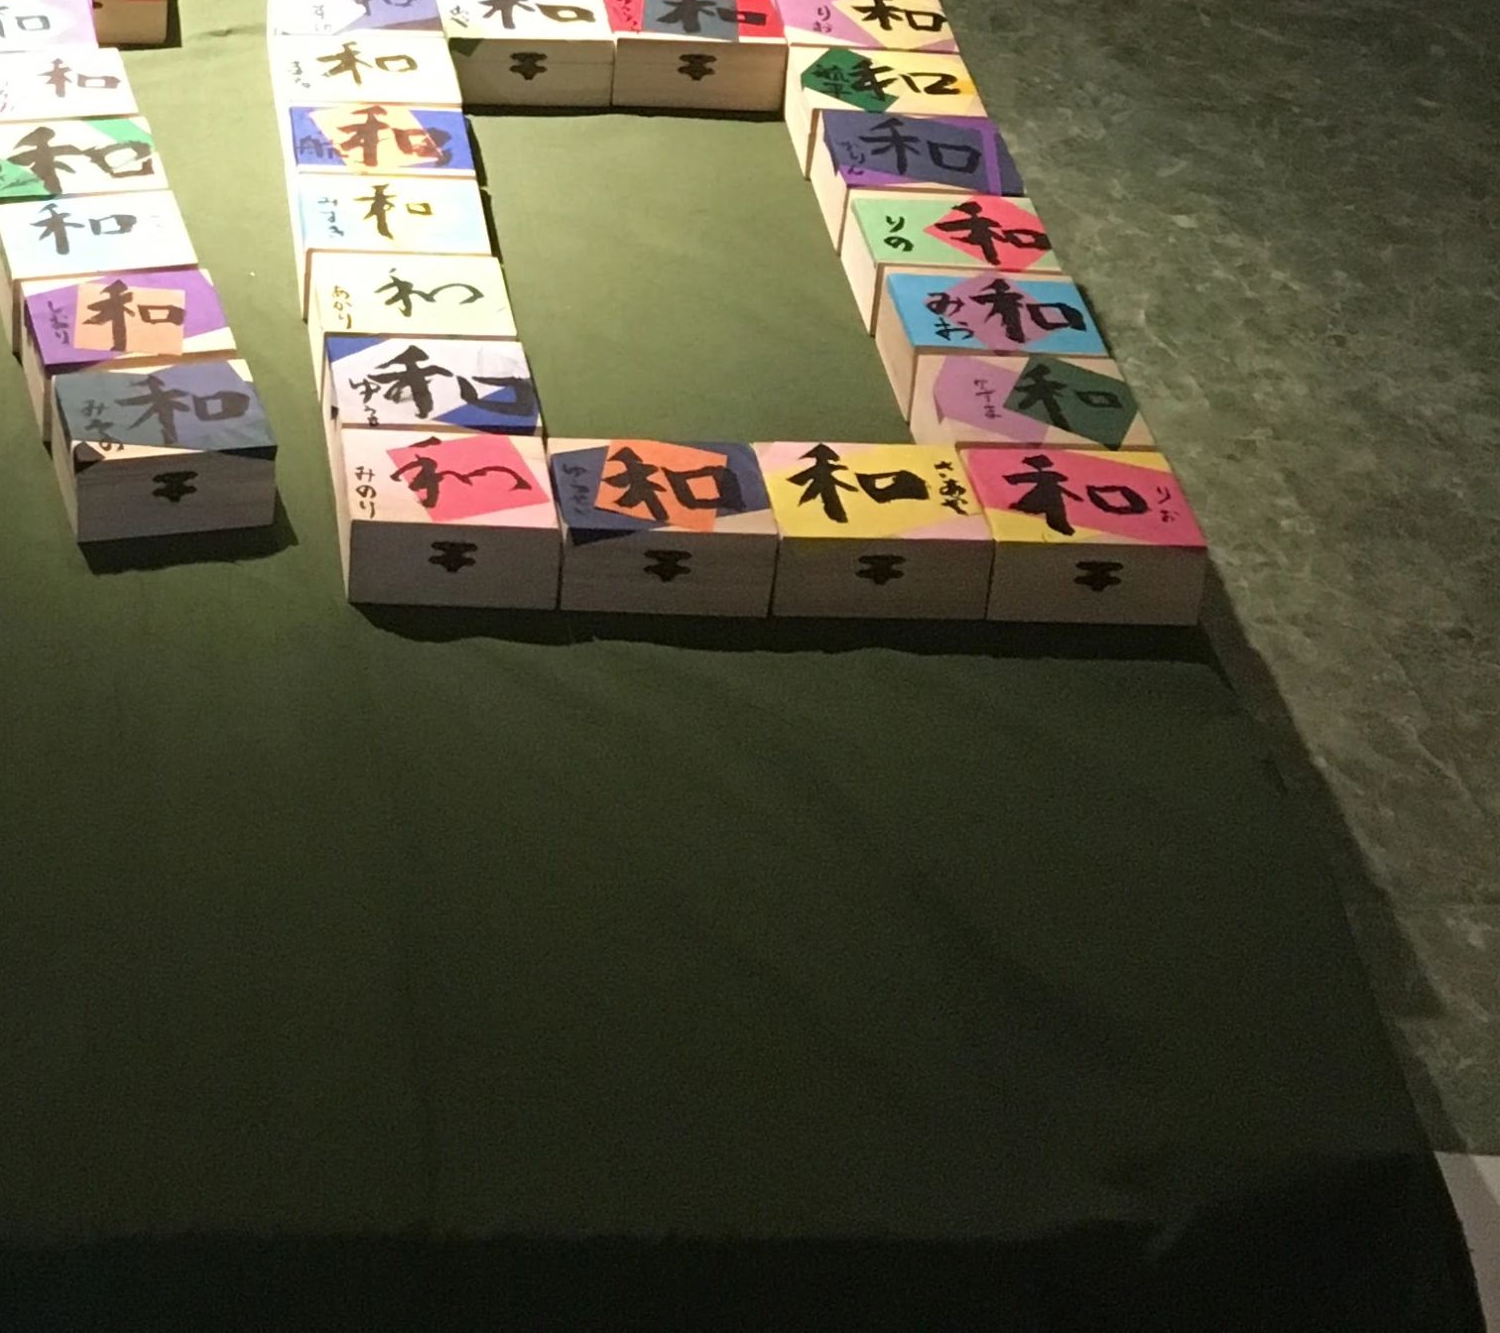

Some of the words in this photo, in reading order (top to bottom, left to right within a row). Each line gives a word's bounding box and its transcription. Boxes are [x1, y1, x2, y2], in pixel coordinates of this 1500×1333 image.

[36, 58, 121, 97] 和
[316, 41, 418, 85] 和
[849, 59, 961, 102] 和
[6, 126, 154, 195] 和
[337, 105, 453, 167] 和
[858, 118, 982, 175] 和
[30, 203, 137, 255] 和
[353, 183, 433, 240] 和
[884, 215, 915, 252] りの
[934, 201, 1052, 265] 和
[82, 279, 188, 351] 和
[927, 292, 975, 341] みお
[969, 278, 1087, 343] 和
[114, 374, 251, 445] 和
[367, 345, 535, 420] 和
[1014, 364, 1123, 432] 和
[355, 465, 377, 518] みのり
[390, 436, 533, 508] 和
[602, 446, 746, 522] 和
[787, 443, 930, 523] 和
[1002, 454, 1150, 536] 和
